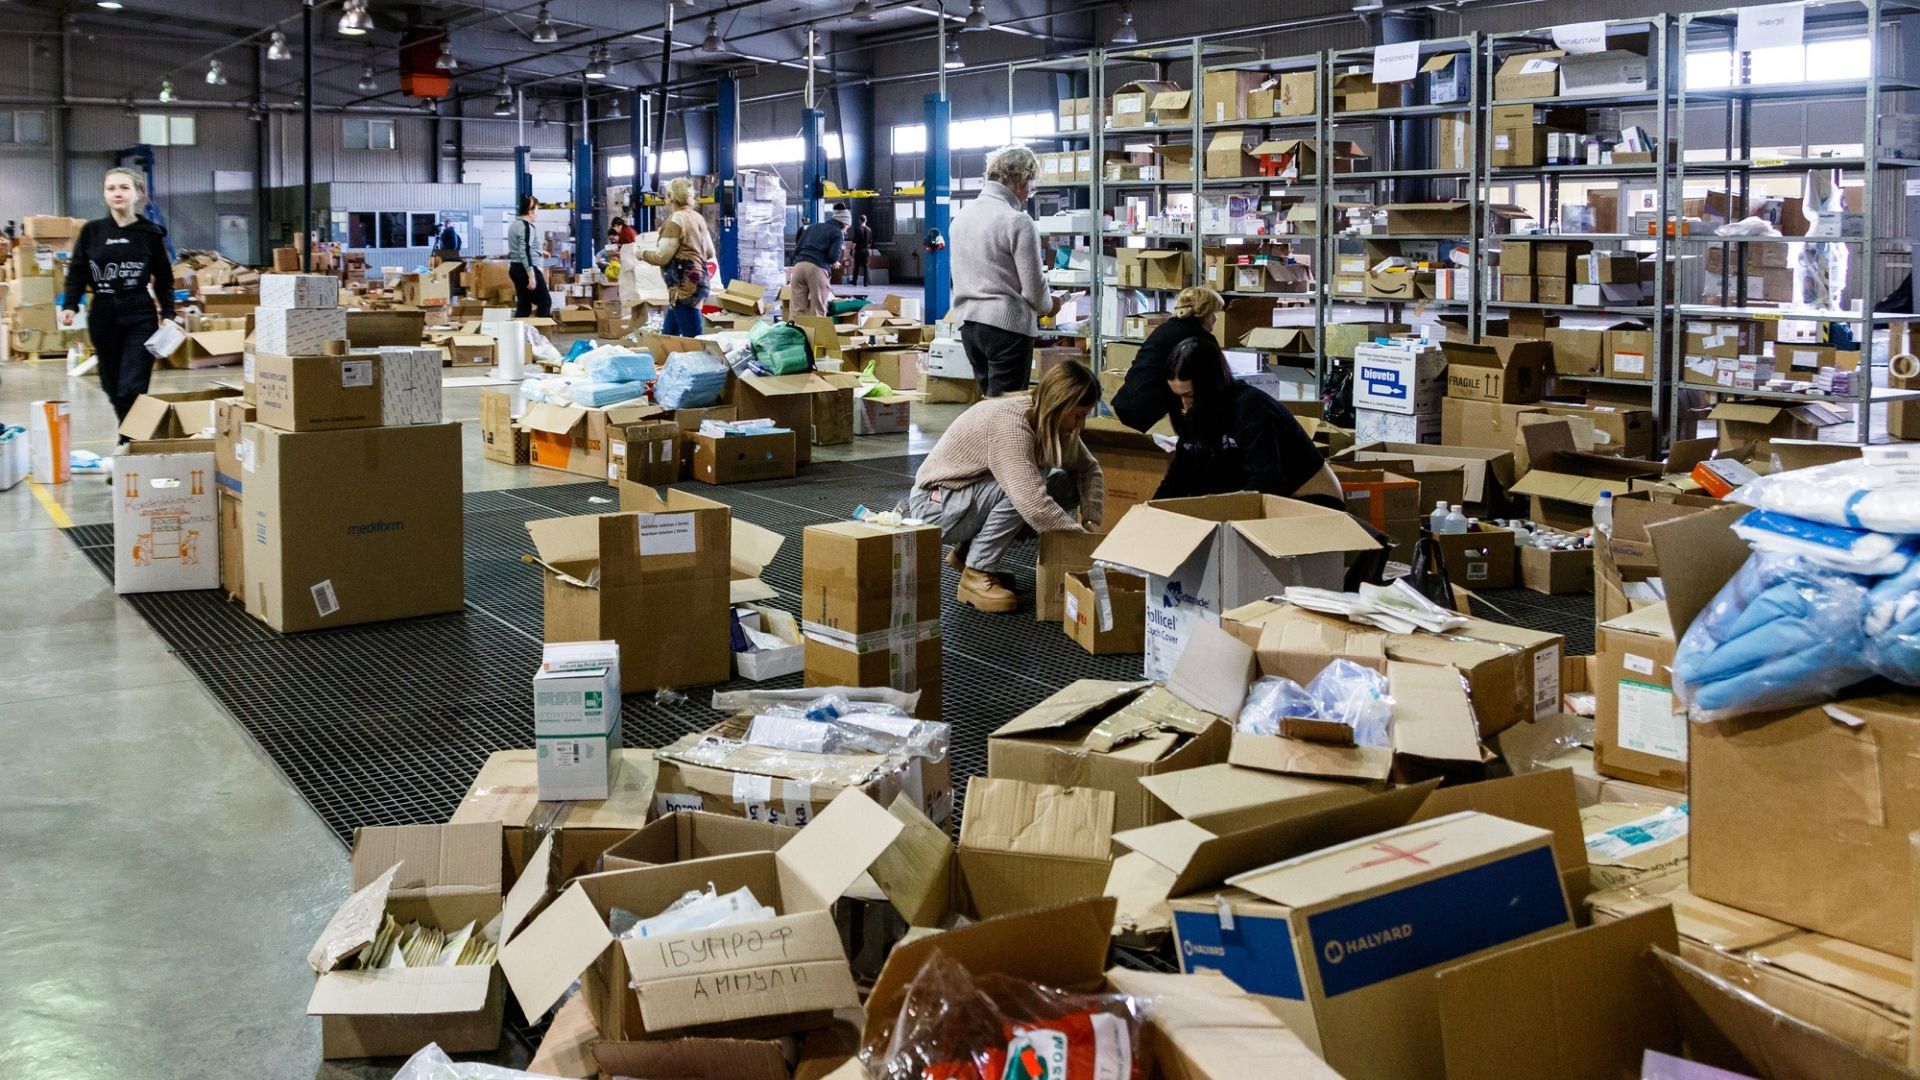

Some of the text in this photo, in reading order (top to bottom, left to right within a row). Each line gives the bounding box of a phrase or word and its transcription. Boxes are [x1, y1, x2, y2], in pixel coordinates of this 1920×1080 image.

[1364, 368, 1396, 383] bioveta
[1449, 375, 1480, 389] FRAGILE
[347, 520, 404, 535] mediform
[1347, 924, 1413, 954] HALYARD
[1193, 944, 1225, 956] HALYARD
[693, 965, 808, 1000] АМПУЛИ
